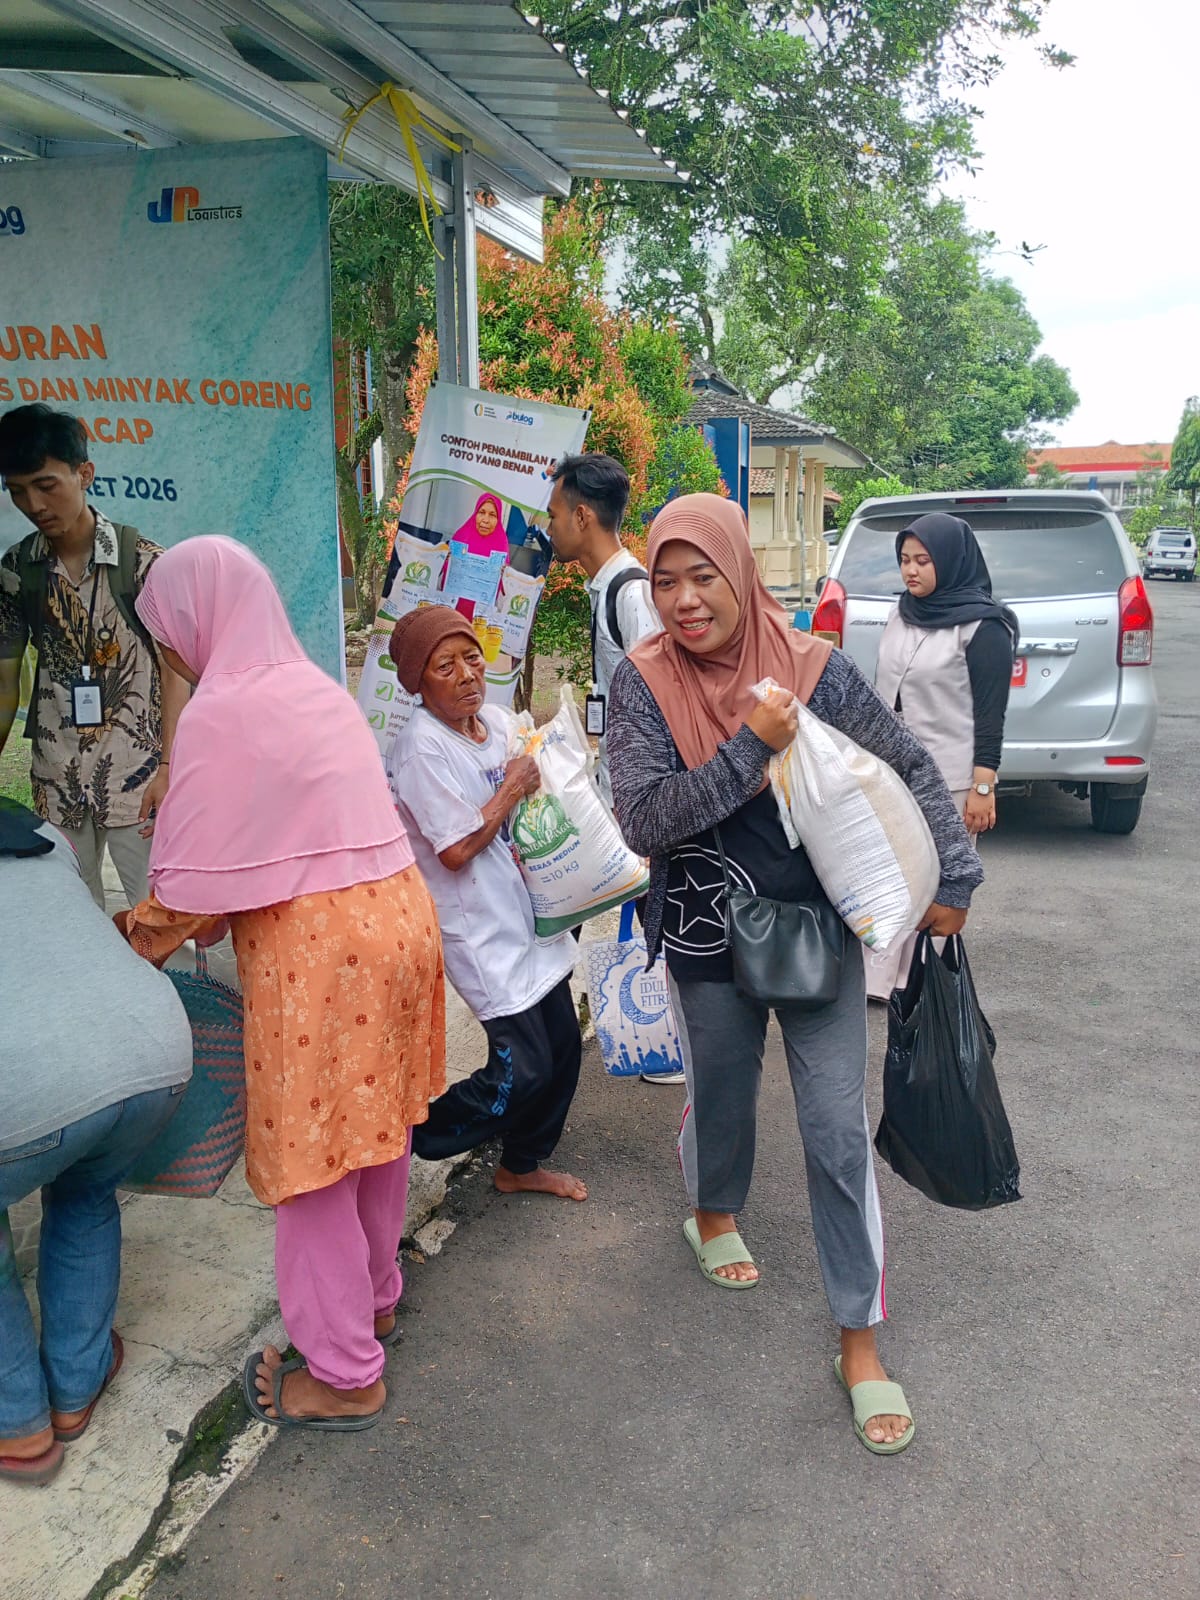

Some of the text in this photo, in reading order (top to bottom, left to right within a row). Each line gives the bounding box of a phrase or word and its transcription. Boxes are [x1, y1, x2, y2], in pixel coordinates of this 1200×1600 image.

[17, 378, 79, 401] DAN
[83, 377, 195, 404] MINYAK
[199, 379, 312, 411] GORENG
[513, 411, 534, 426] bulog
[440, 434, 548, 465] CONTOH PENGAMBILAN
[449, 448, 534, 475] FOTO YANG BENAR
[122, 476, 177, 501] 2026
[528, 839, 581, 872] BERAS MEDIUM
[563, 860, 580, 874] kg
[640, 981, 667, 994] IDUL
[641, 993, 670, 1007] FITRI
